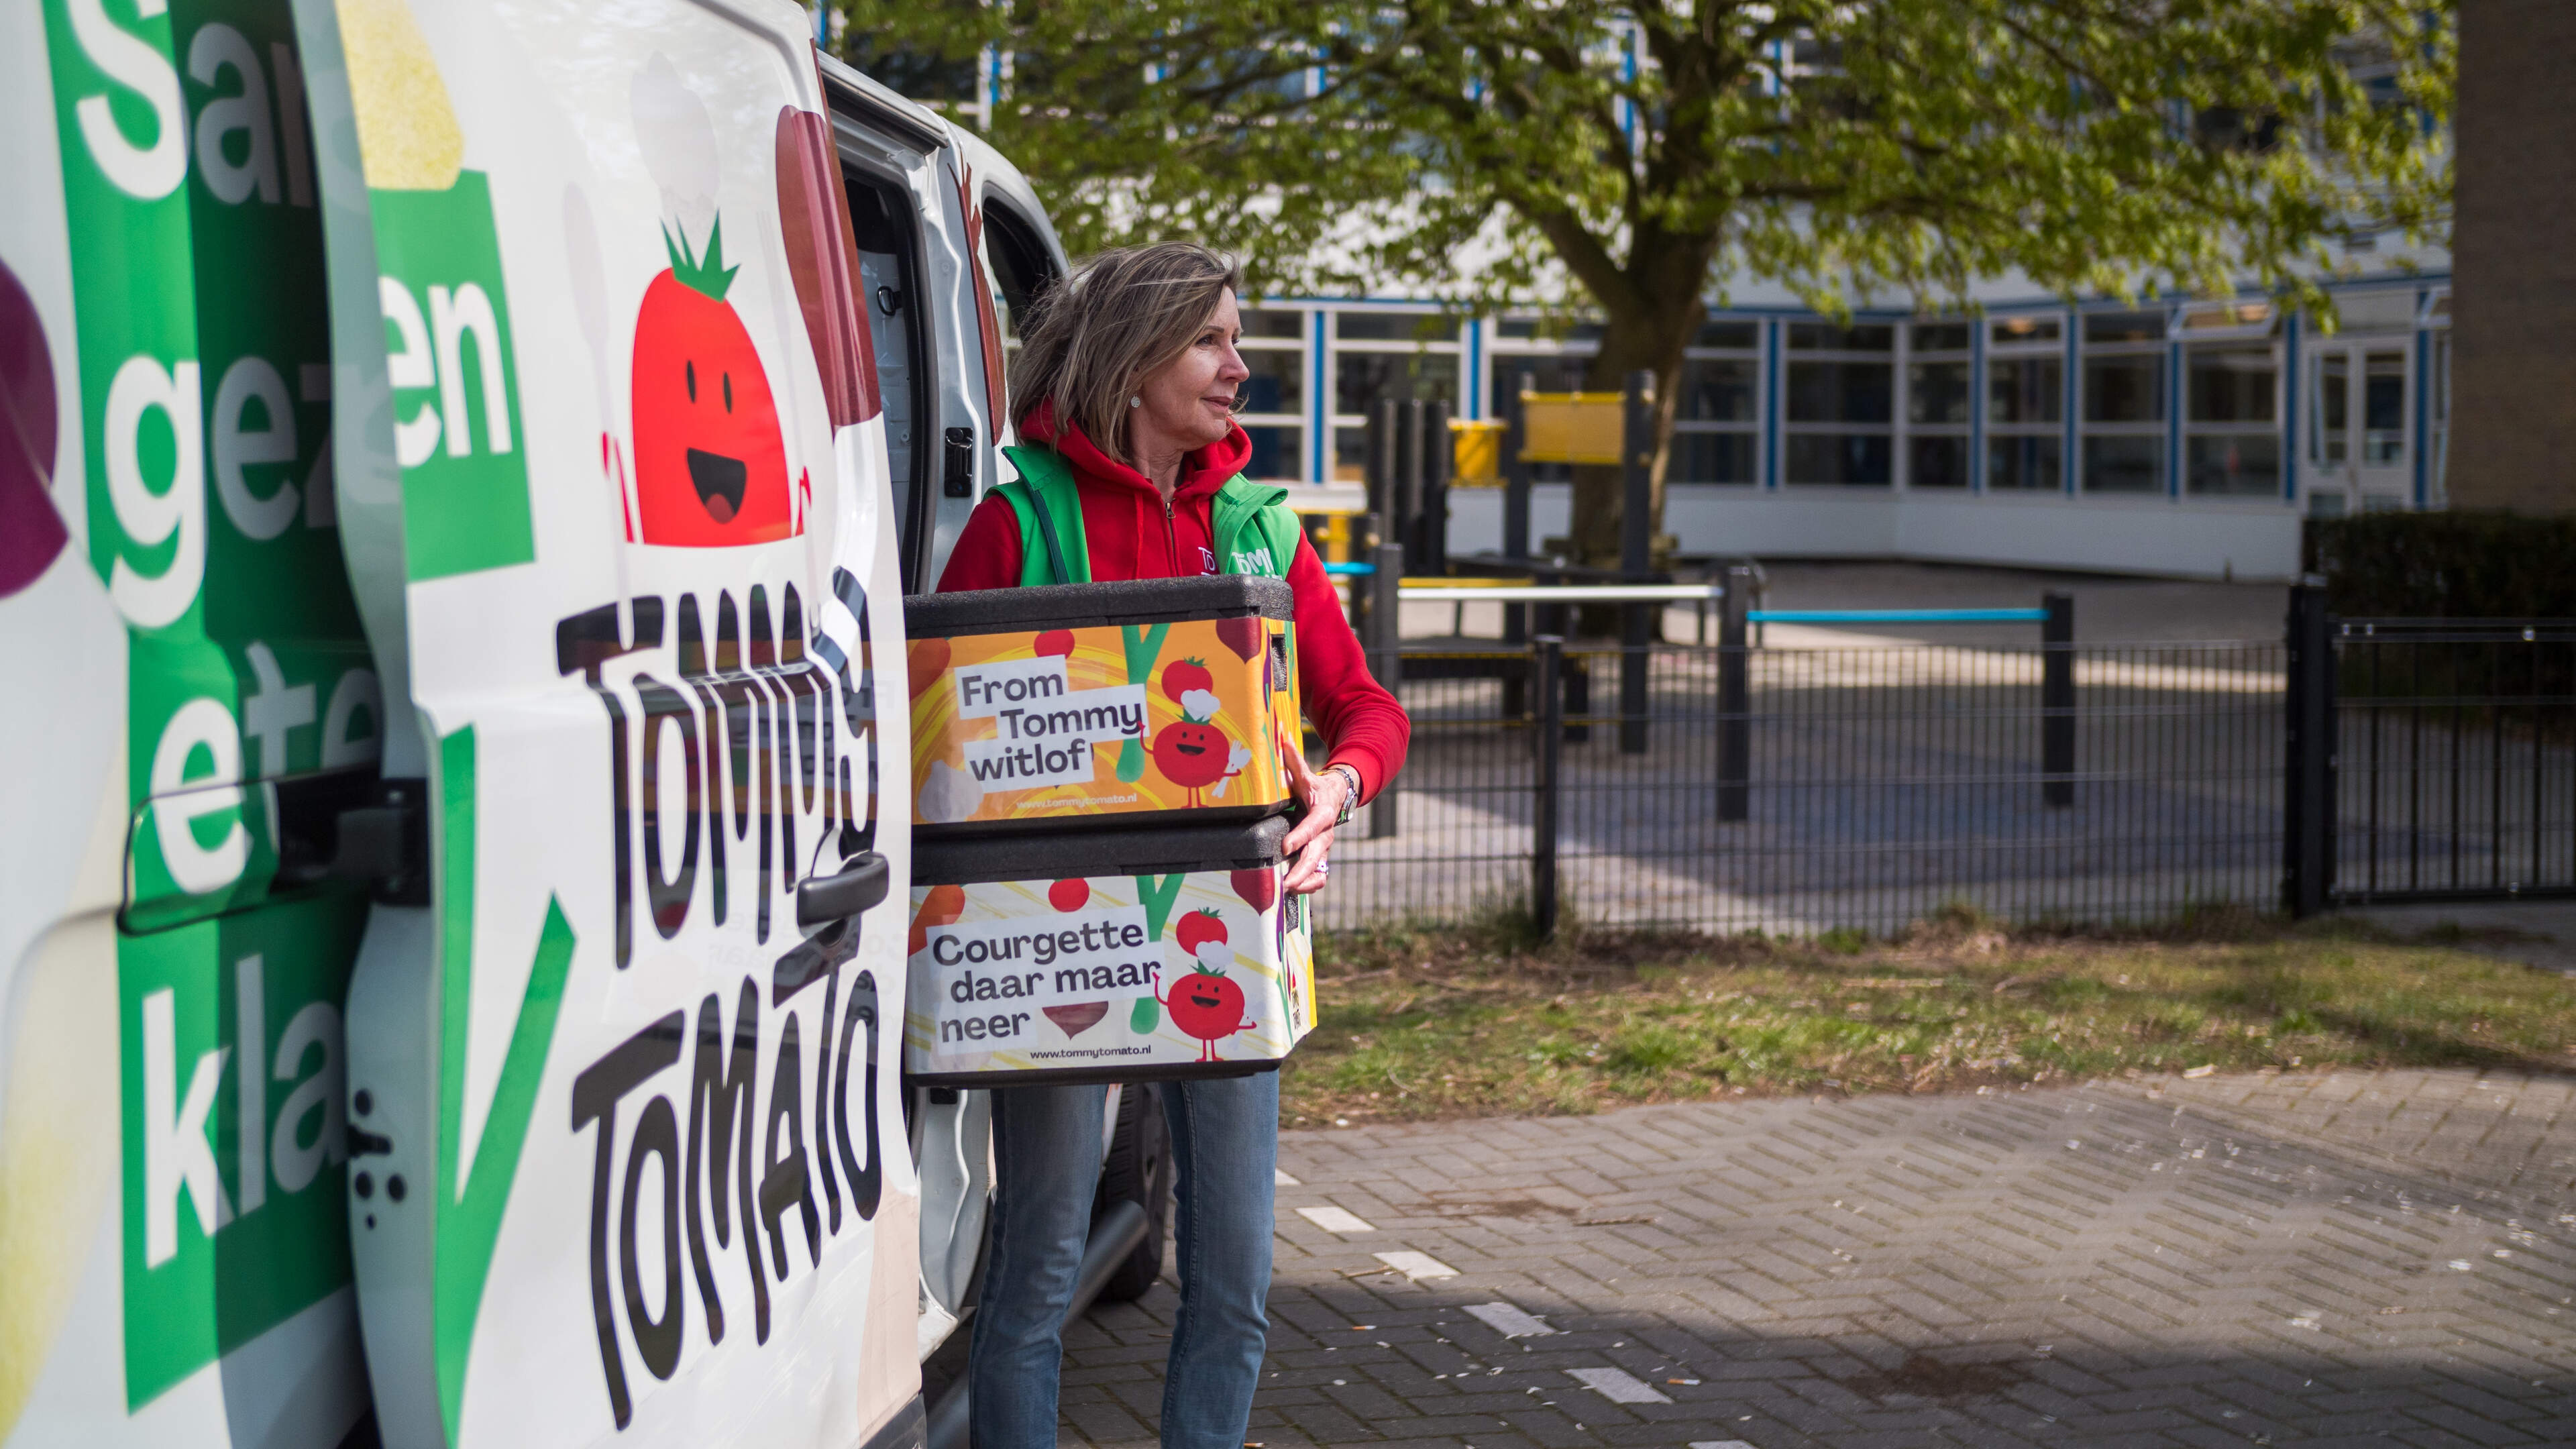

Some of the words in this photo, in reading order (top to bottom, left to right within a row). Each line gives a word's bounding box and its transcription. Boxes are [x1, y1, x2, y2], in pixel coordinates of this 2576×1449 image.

[66, 0, 313, 207] Sa
[961, 674, 1064, 707] From
[1000, 703, 1142, 739] Tommy
[557, 566, 877, 970] TOMMY
[970, 738, 1086, 782] witlof
[1016, 793, 1137, 810] www.tommytomato.nl
[932, 920, 1144, 966] Courgette
[950, 970, 1044, 1004] daar
[1055, 960, 1161, 993] maar
[941, 1011, 1030, 1043] neer
[1030, 1044, 1152, 1060] www.tommytomato.nl
[572, 916, 883, 1431] TOMATO
